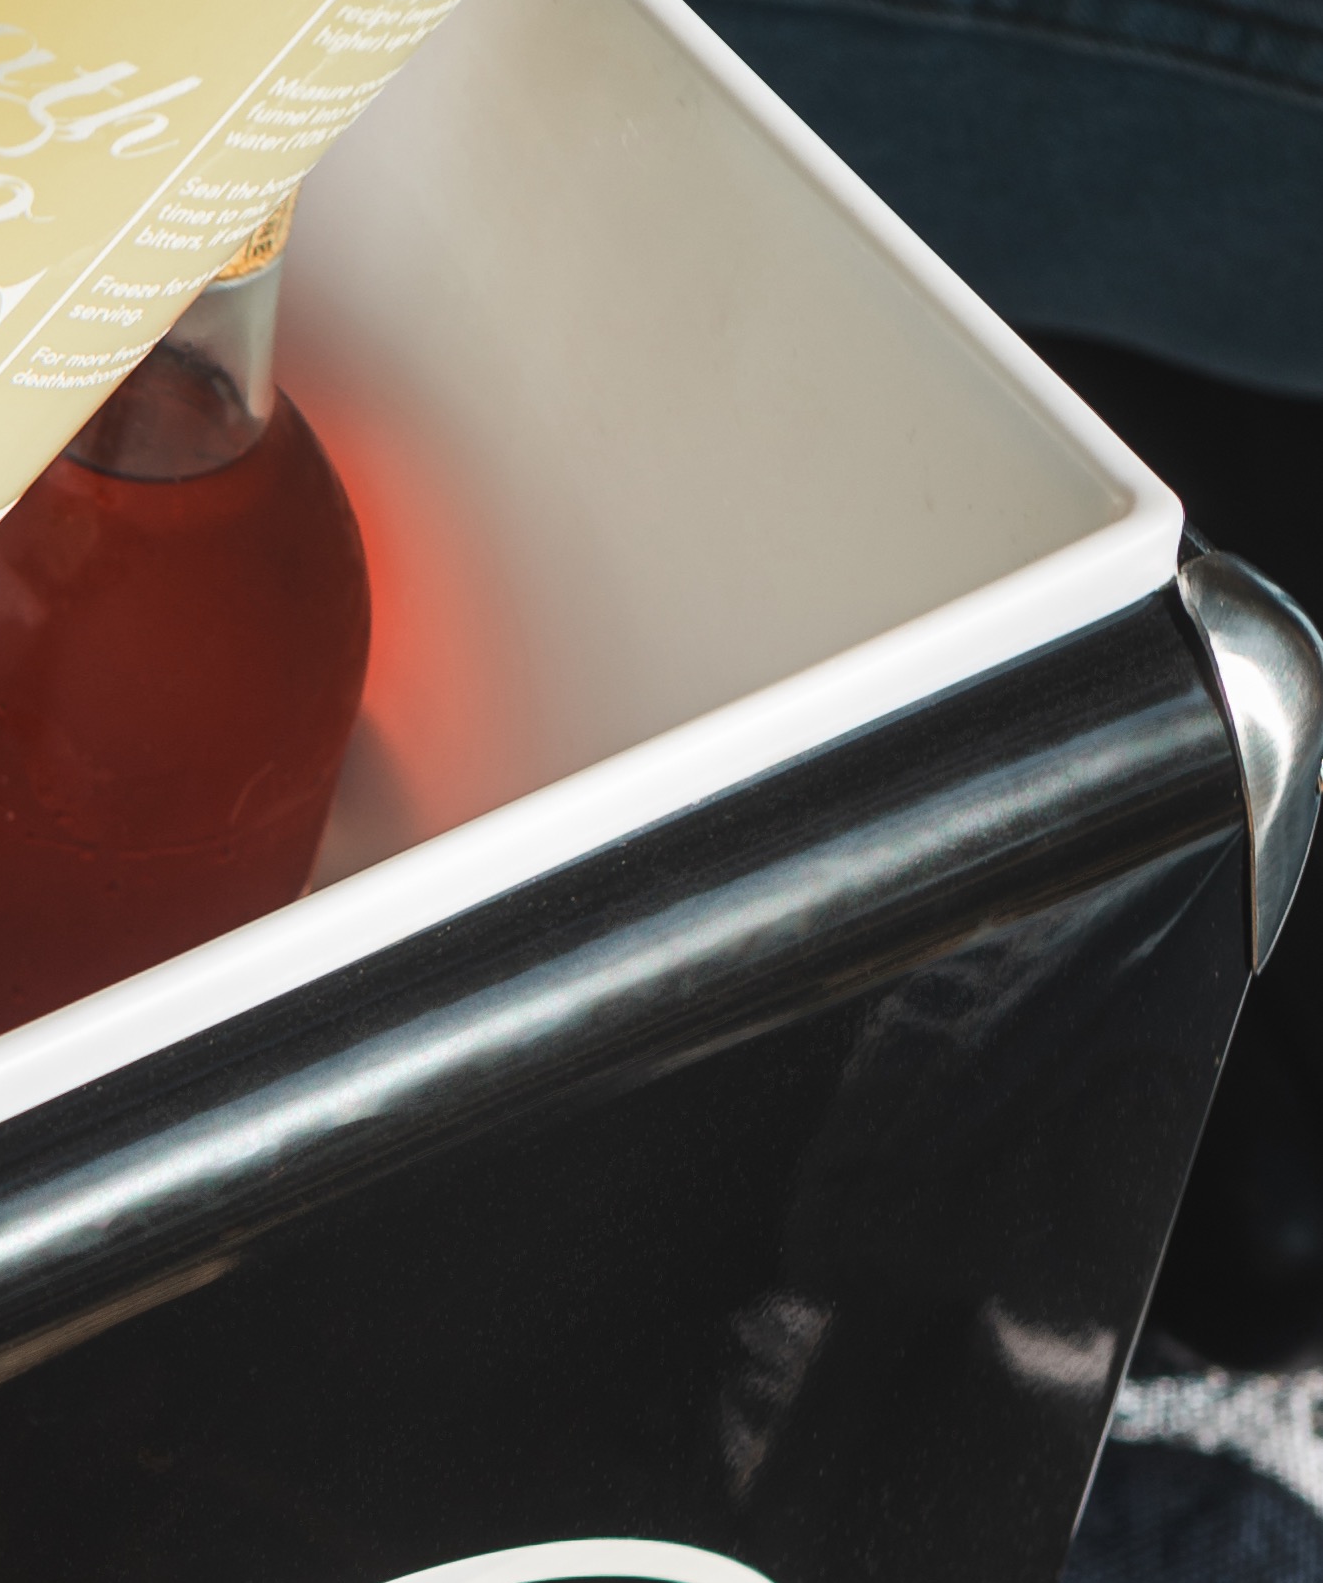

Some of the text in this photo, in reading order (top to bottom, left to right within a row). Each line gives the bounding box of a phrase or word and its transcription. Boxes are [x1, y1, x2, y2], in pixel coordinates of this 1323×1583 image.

[335, 4, 402, 31] recipe
[268, 75, 353, 101] Measure
[246, 99, 316, 127] funnel
[224, 130, 287, 152] water
[179, 176, 231, 200] Seal
[226, 180, 260, 201] the
[157, 202, 216, 225] times
[215, 208, 239, 225] to
[134, 224, 204, 251] bitters,
[91, 274, 162, 299] Freeze
[160, 277, 191, 297] for
[68, 304, 144, 328] serving.
[30, 346, 65, 367] For
[65, 351, 112, 367] more
